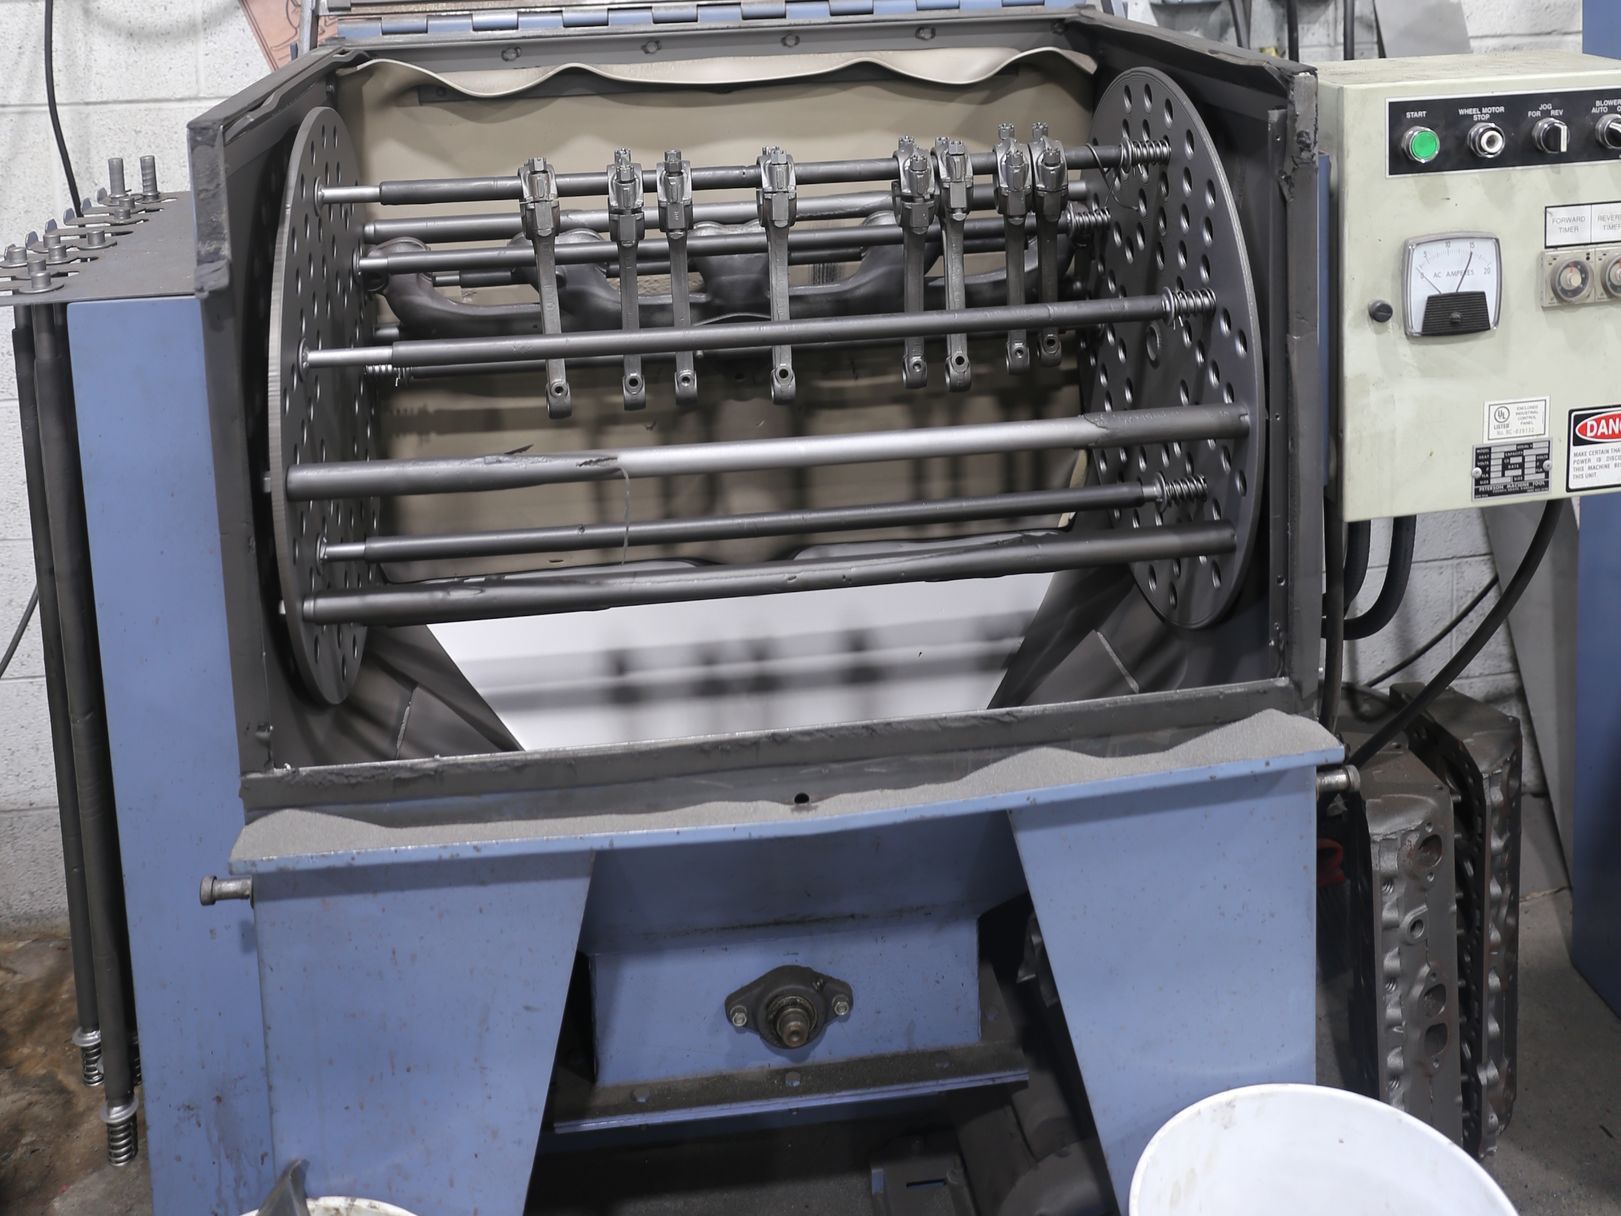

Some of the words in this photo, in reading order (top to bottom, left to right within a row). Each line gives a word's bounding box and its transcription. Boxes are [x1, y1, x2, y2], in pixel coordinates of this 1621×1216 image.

[1458, 107, 1480, 116] WHEEL
[1481, 106, 1505, 115] MOTOR
[1538, 103, 1552, 111] JOG
[1591, 106, 1609, 114] AUTO
[1406, 110, 1427, 119] START
[1473, 113, 1490, 122] STOP
[1527, 110, 1541, 118] FOR
[1550, 109, 1564, 117] REV
[1552, 215, 1586, 225] FORWARD
[1559, 226, 1580, 234] TIMER
[1433, 271, 1441, 279] AC
[1445, 269, 1474, 278] AMPERES
[1483, 267, 1491, 275] 20
[1586, 417, 1621, 438] DAN
[1573, 450, 1587, 458] MAKE
[1588, 448, 1610, 457] CERTAIN
[1573, 457, 1592, 465] POWER
[1573, 465, 1585, 473] THIS
[1587, 463, 1610, 471] MACHINE
[1573, 473, 1584, 481] THIS
[1585, 471, 1597, 479] UNIT
